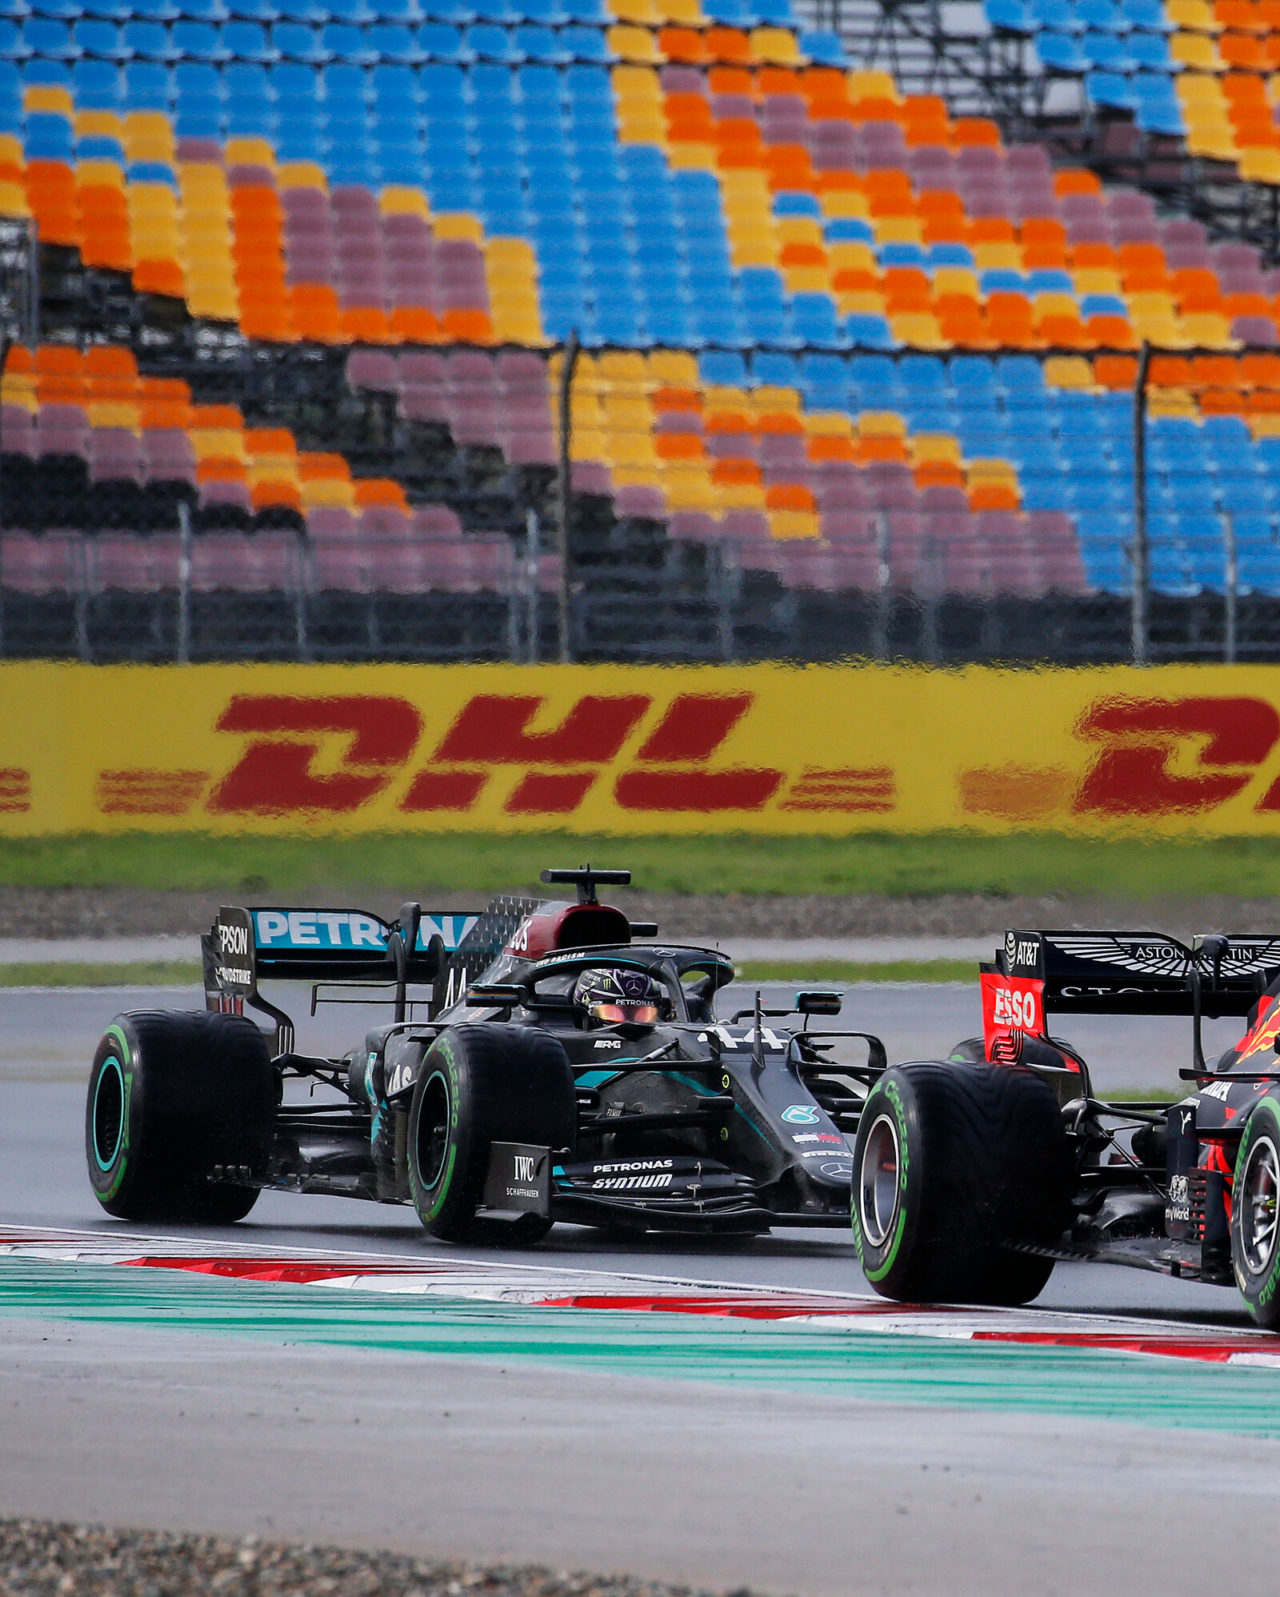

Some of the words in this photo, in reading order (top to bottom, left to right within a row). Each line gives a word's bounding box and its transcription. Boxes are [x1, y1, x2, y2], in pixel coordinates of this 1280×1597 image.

[208, 692, 785, 813] DHL
[257, 911, 480, 948] PETRN
[1016, 941, 1040, 966] AT&T
[1136, 946, 1185, 959] ASTON
[615, 999, 655, 1007] PETRONAS
[993, 988, 1035, 1029] ESSO
[697, 1026, 789, 1049] 44
[513, 1155, 535, 1182] IWC
[593, 1159, 673, 1173] PETRONAS
[592, 1173, 673, 1189] SYNTIUM
[506, 1187, 539, 1199] SCHAFFHAUSEN
[1165, 1208, 1190, 1221] myWorld
